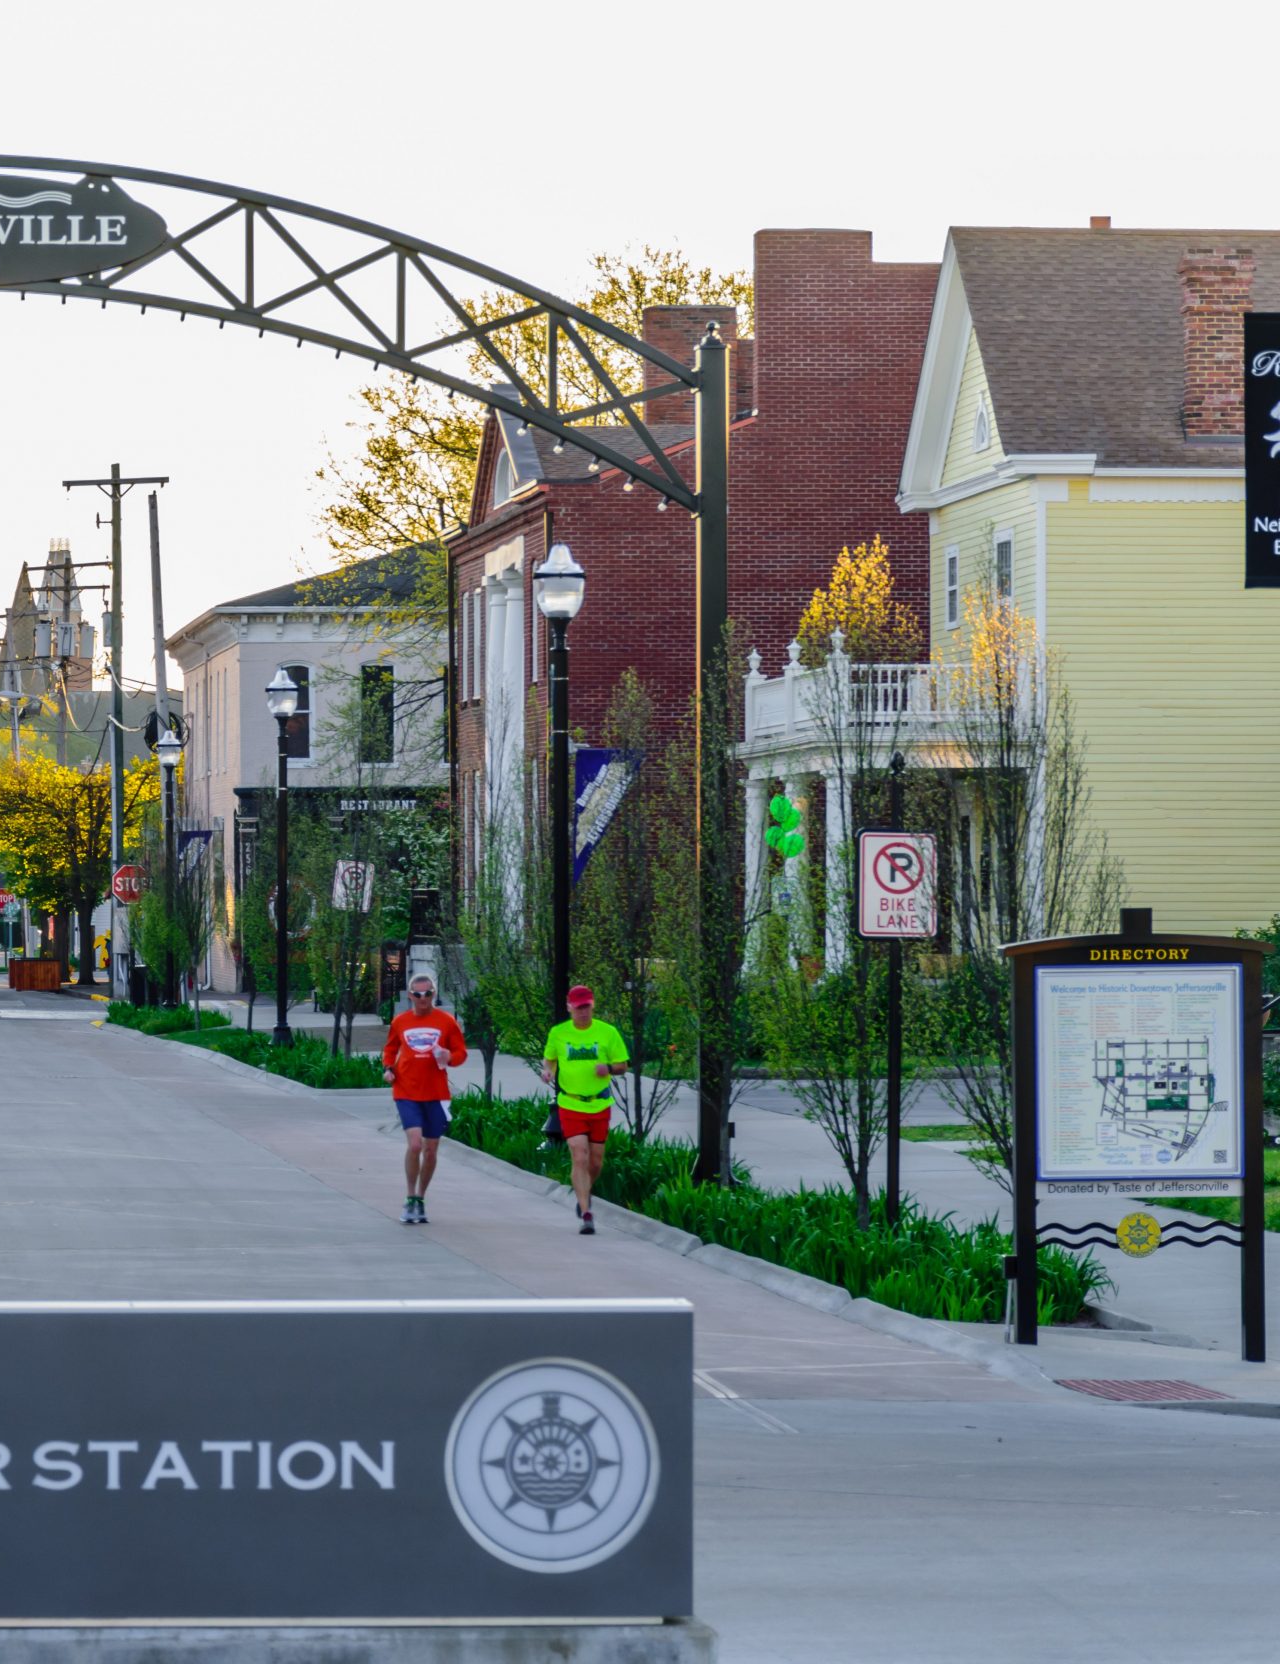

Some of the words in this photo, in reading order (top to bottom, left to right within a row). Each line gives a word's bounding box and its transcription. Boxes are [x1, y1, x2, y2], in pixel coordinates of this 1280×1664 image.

[880, 898, 916, 912] BIKE
[877, 914, 918, 928] LANE
[1089, 948, 1190, 961] DIRECTORY
[1049, 984, 1086, 994] Welcome
[1087, 984, 1098, 993] to
[1098, 983, 1128, 993] Historic
[1130, 983, 1172, 993] Downtown
[1174, 982, 1227, 994] Jeffersonville
[1047, 1183, 1094, 1194] Donated
[1097, 1183, 1110, 1196] by
[1113, 1182, 1142, 1193] Taste
[1144, 1182, 1156, 1193] of
[1158, 1181, 1229, 1193] Jeffersonville
[32, 1440, 395, 1491] STATION
